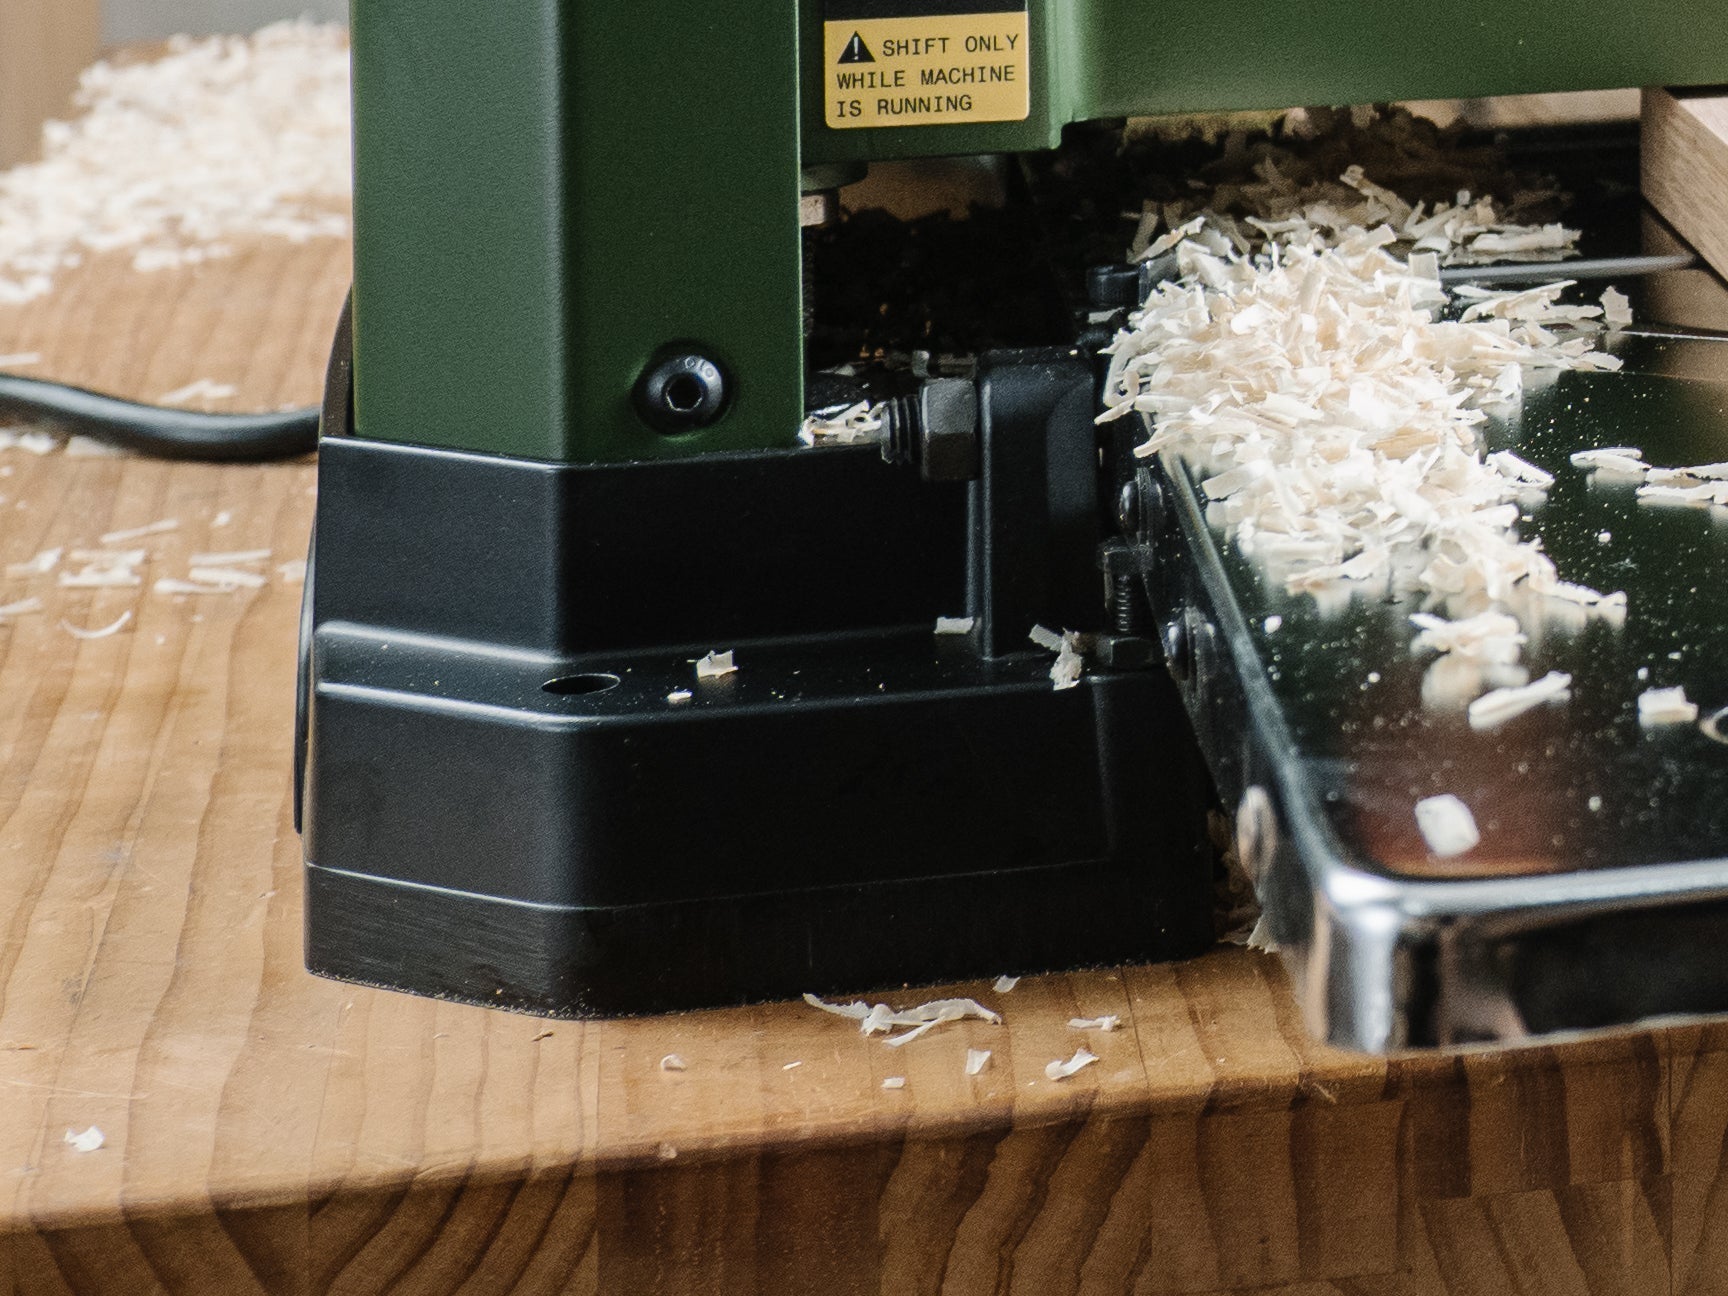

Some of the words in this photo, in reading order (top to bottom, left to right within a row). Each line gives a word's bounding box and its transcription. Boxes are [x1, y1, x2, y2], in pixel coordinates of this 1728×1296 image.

[882, 36, 950, 57] SHIFT
[965, 33, 1019, 53] ONLY
[836, 70, 906, 90] WHILE
[920, 65, 1016, 86] MACHINE
[836, 100, 862, 118] IS
[877, 95, 973, 116] RUNNING
